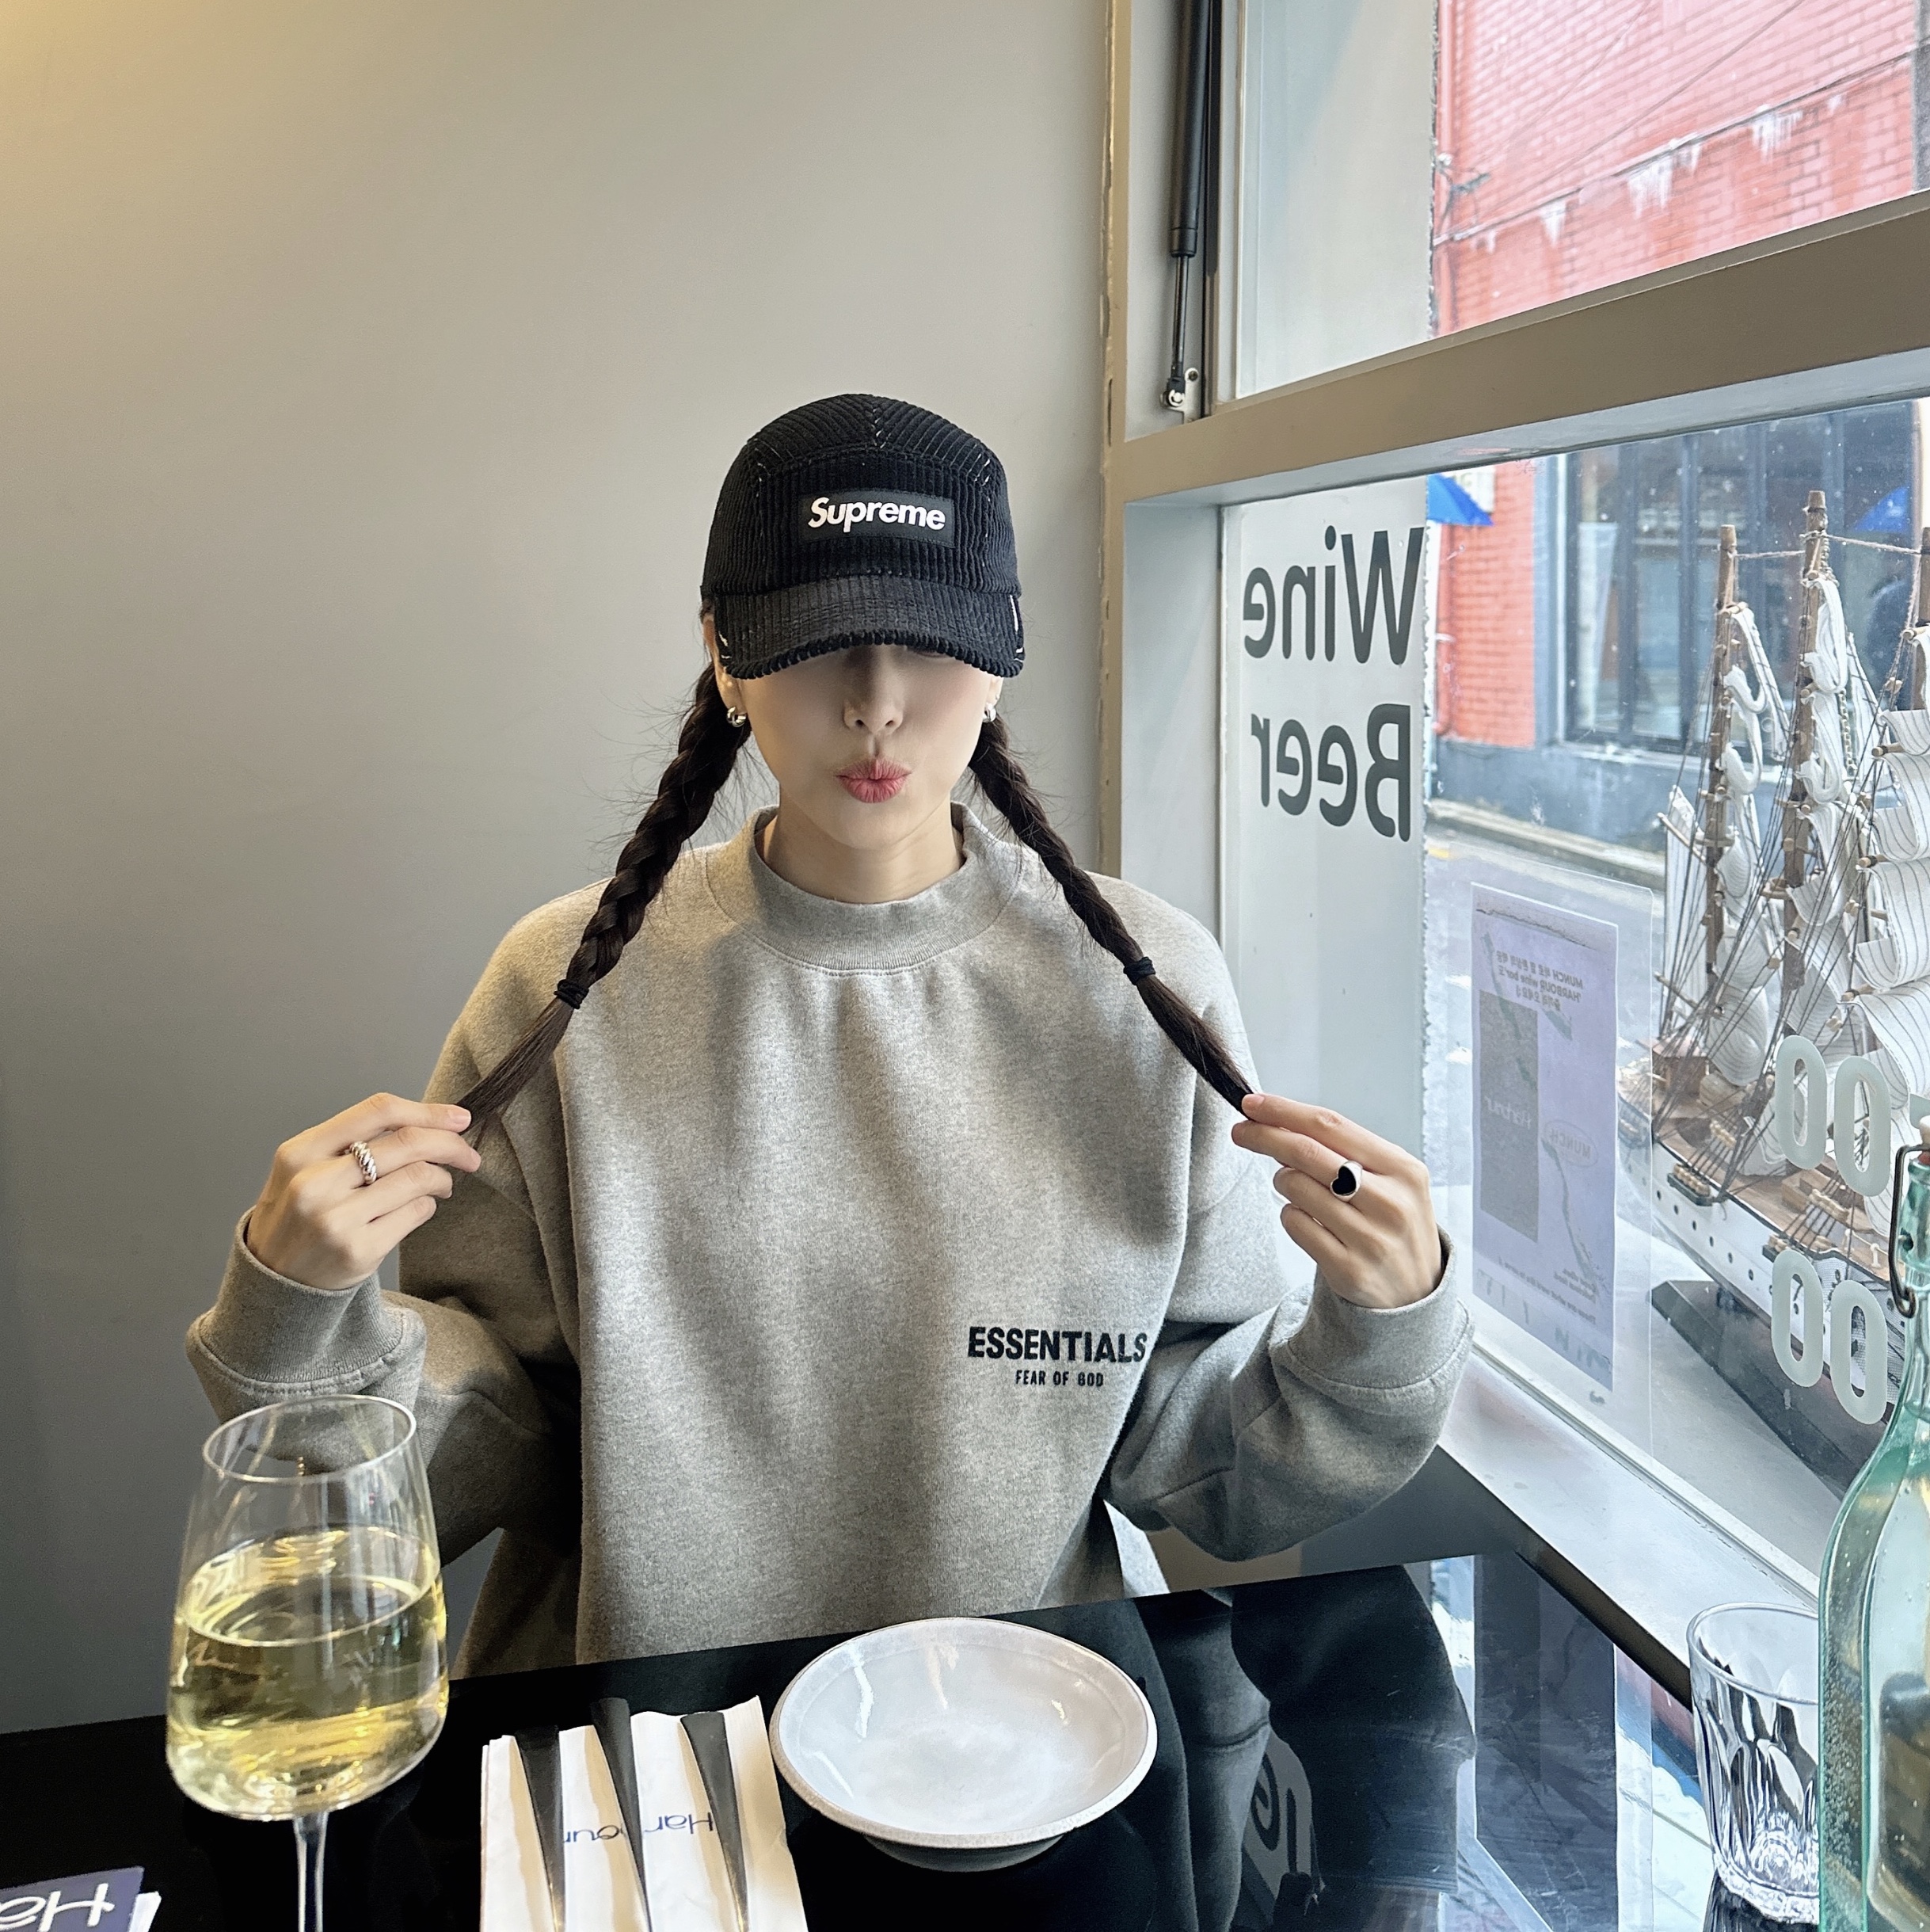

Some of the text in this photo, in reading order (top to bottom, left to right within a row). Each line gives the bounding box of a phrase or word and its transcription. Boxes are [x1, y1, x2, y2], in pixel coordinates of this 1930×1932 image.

[807, 497, 946, 533] Supreme
[968, 1326, 1148, 1363] ESSENTIALS
[1015, 1370, 1104, 1387] FEAR OF GOD
[563, 1812, 714, 1843] Harour
